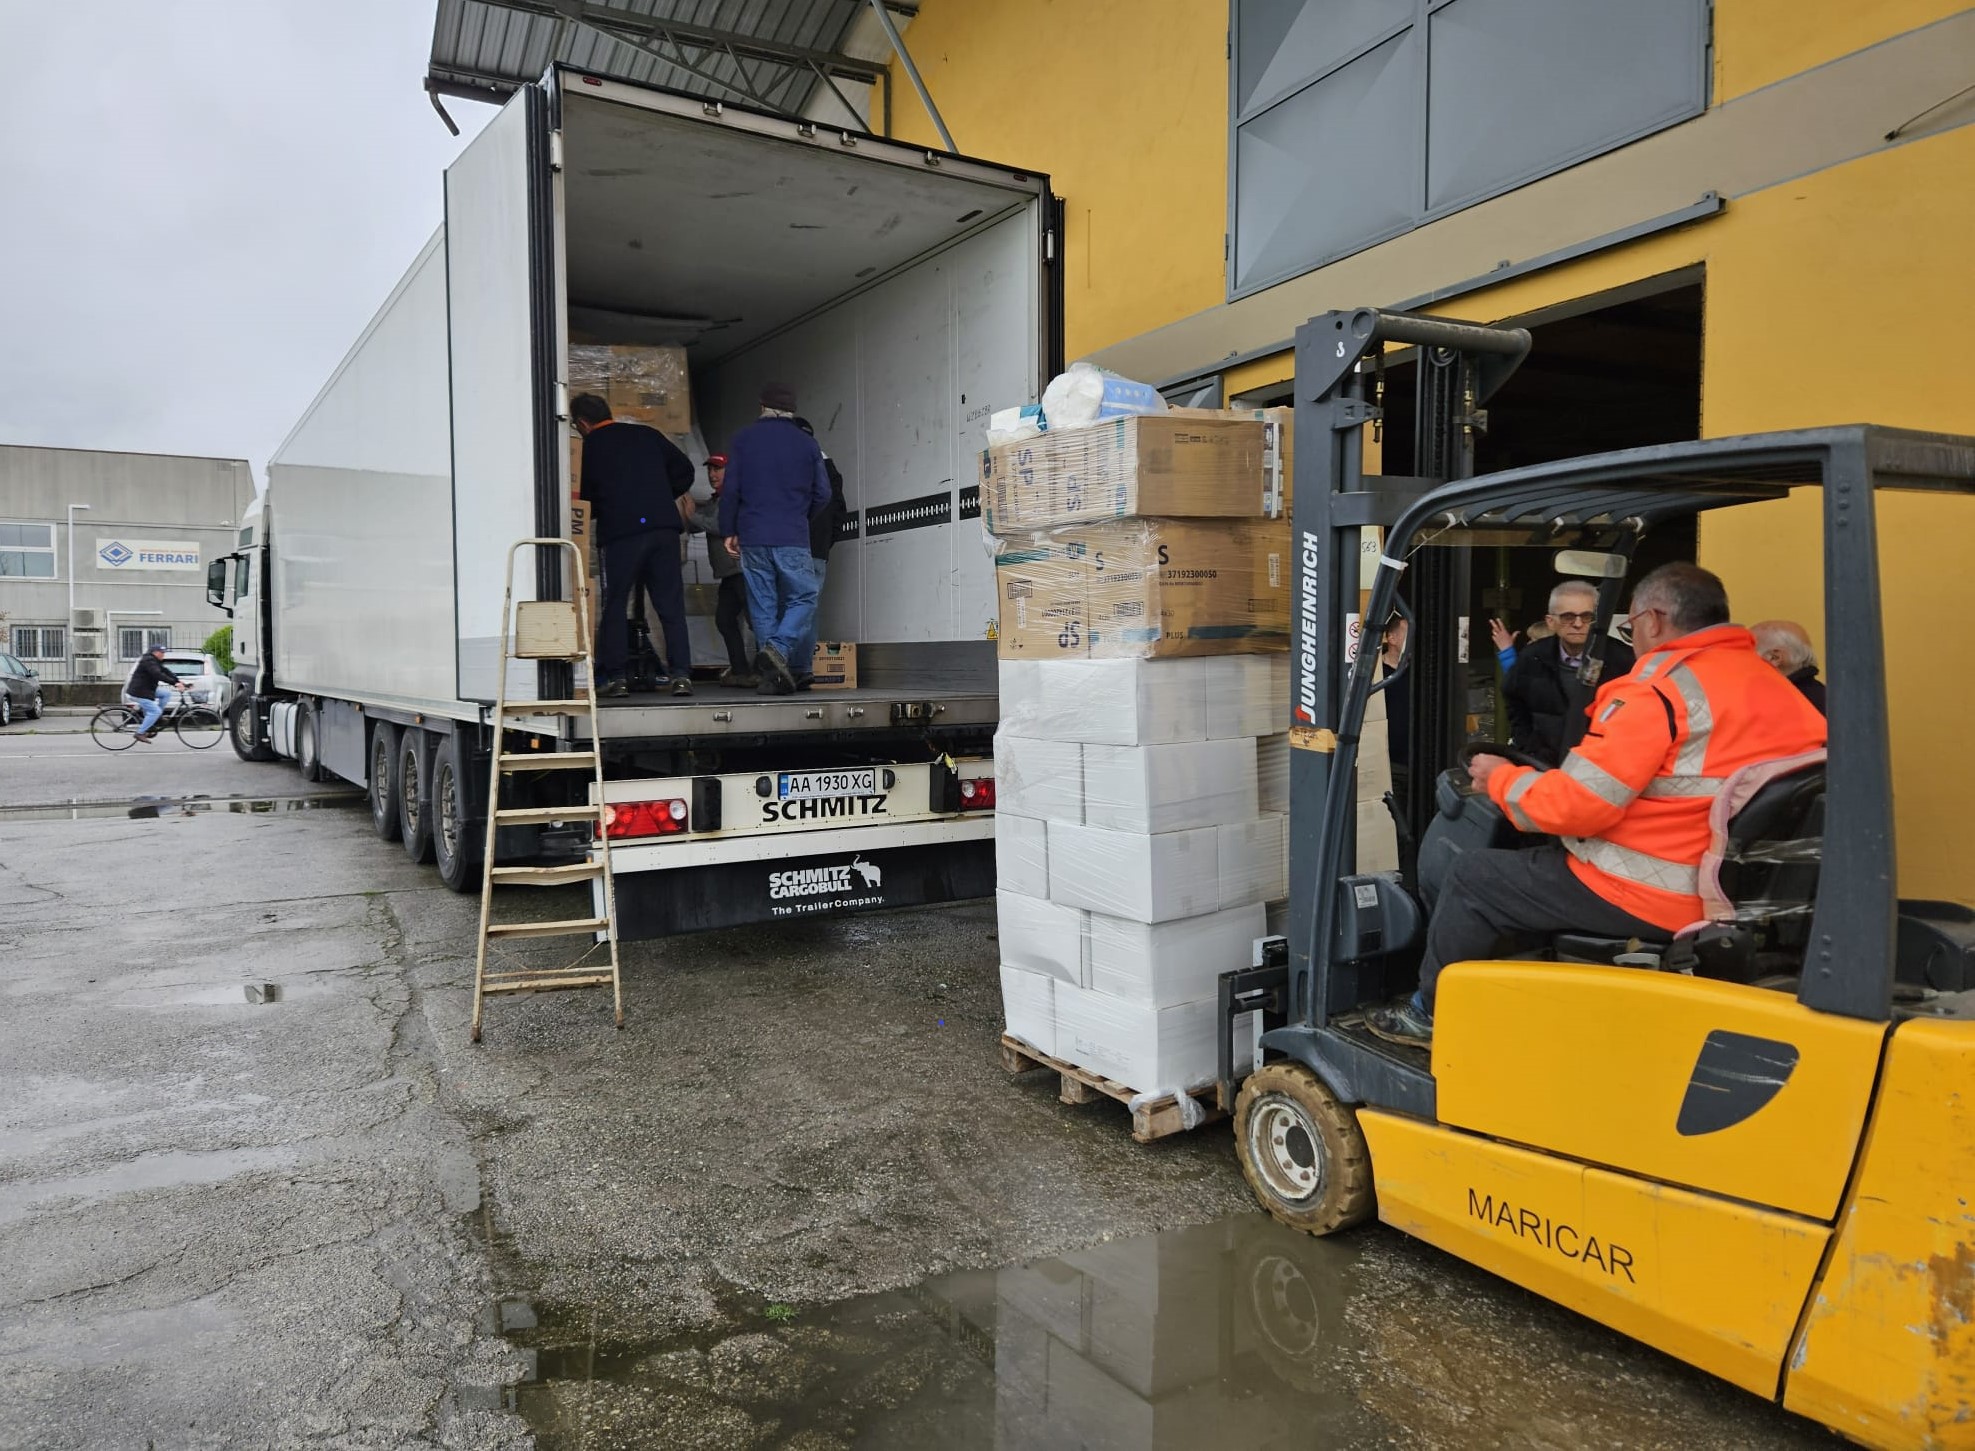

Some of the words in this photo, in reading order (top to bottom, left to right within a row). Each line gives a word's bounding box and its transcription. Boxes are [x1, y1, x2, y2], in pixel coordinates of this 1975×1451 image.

[139, 553, 198, 564] FERRARI
[1296, 531, 1318, 724] JUNGHEINRICH
[790, 777, 811, 792] AA
[816, 775, 848, 791] 1930
[852, 773, 871, 790] XG
[762, 794, 887, 822] SCHMITZ
[769, 865, 851, 887] SCHMITZ
[769, 879, 852, 899] CARGOBULL
[771, 906, 792, 916] The
[795, 901, 833, 913] Trailer
[1468, 1187, 1636, 1284] MARICAR
